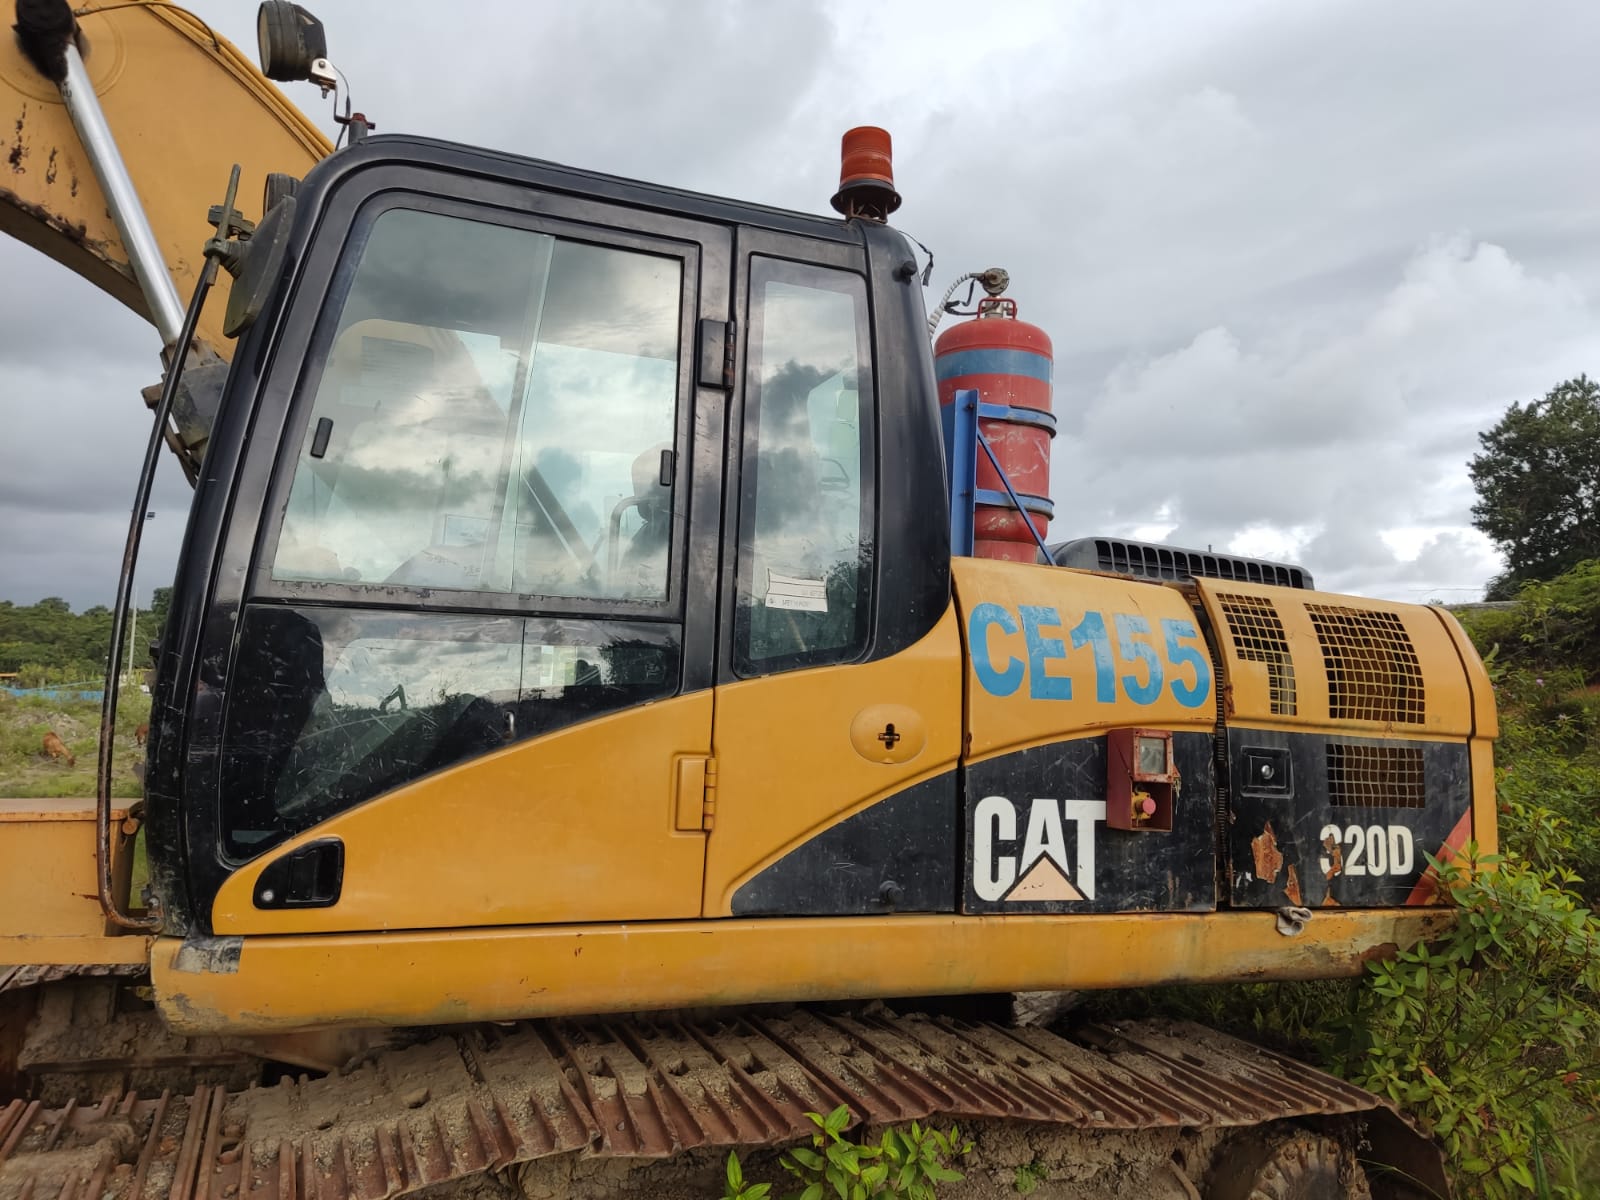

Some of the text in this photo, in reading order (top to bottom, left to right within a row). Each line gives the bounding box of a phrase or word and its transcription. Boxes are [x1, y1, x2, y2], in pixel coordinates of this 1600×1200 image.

[968, 602, 1210, 708] CE155
[973, 796, 1107, 901] CAT
[1320, 824, 1414, 877] 320D
